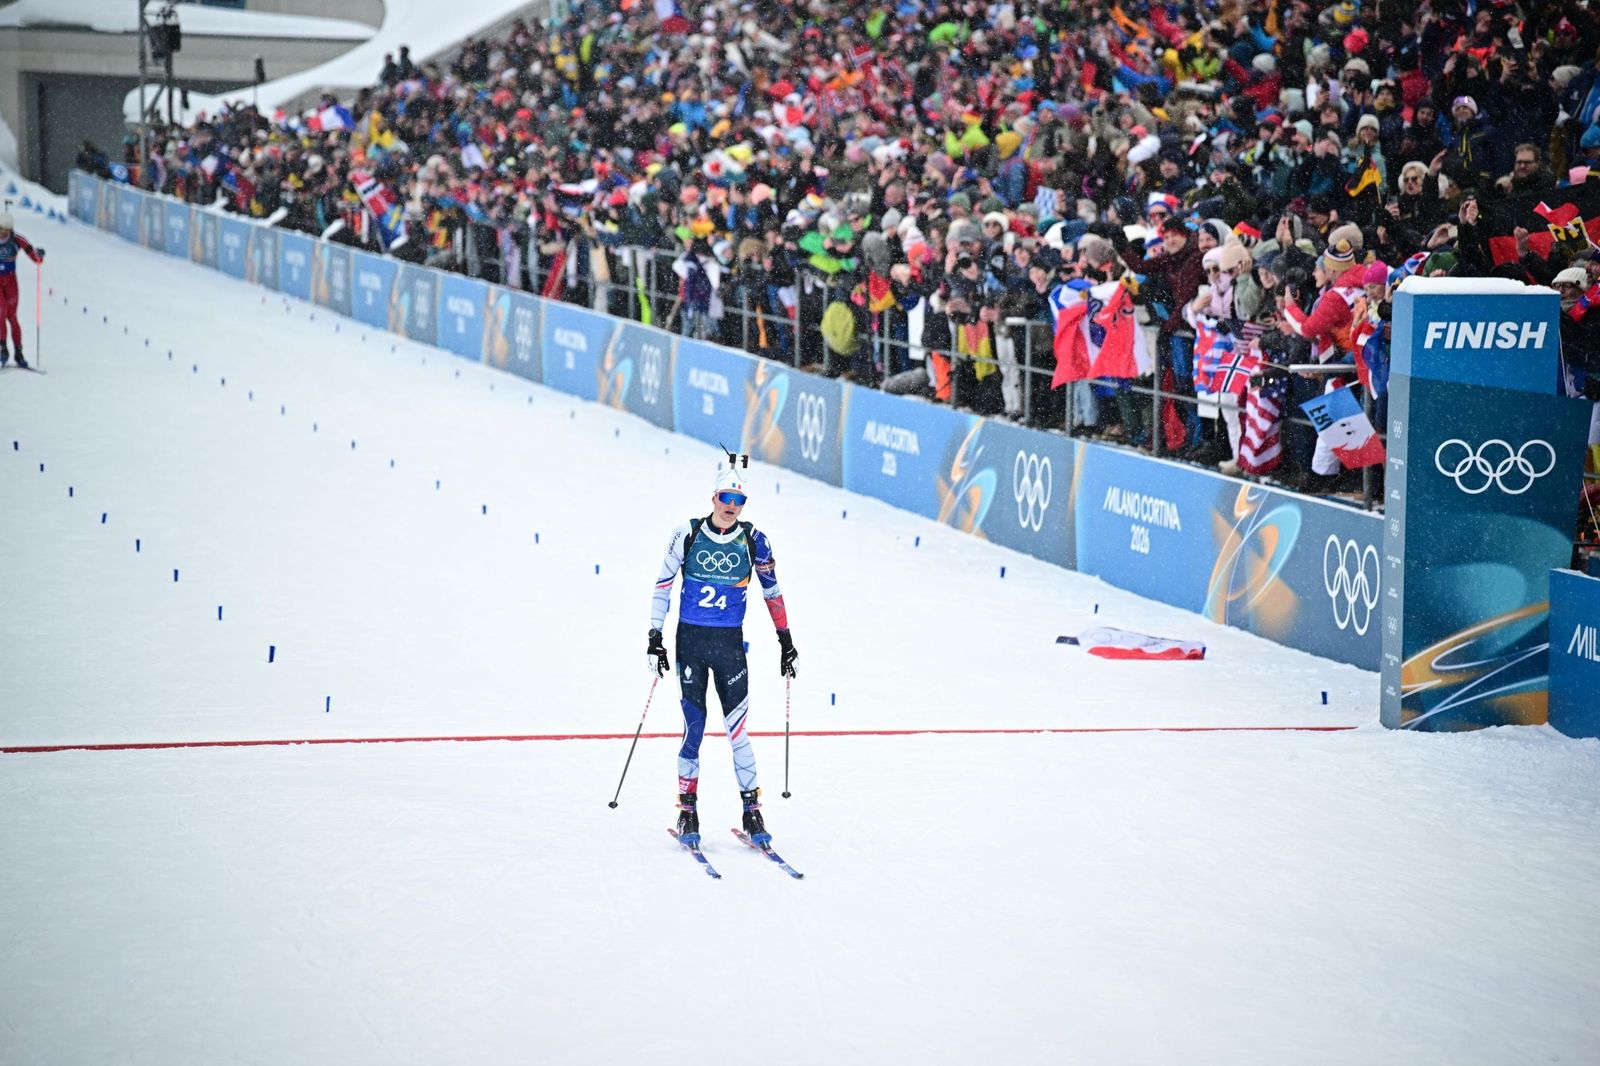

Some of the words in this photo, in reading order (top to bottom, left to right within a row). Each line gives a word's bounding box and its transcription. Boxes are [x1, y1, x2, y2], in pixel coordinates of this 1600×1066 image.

[1424, 321, 1547, 349] FINISH
[1103, 486, 1140, 519] MILANO
[1141, 494, 1181, 532] CORTINA
[1130, 524, 1150, 555] 2026
[698, 585, 727, 610] 24
[727, 670, 745, 685] CRAFT
